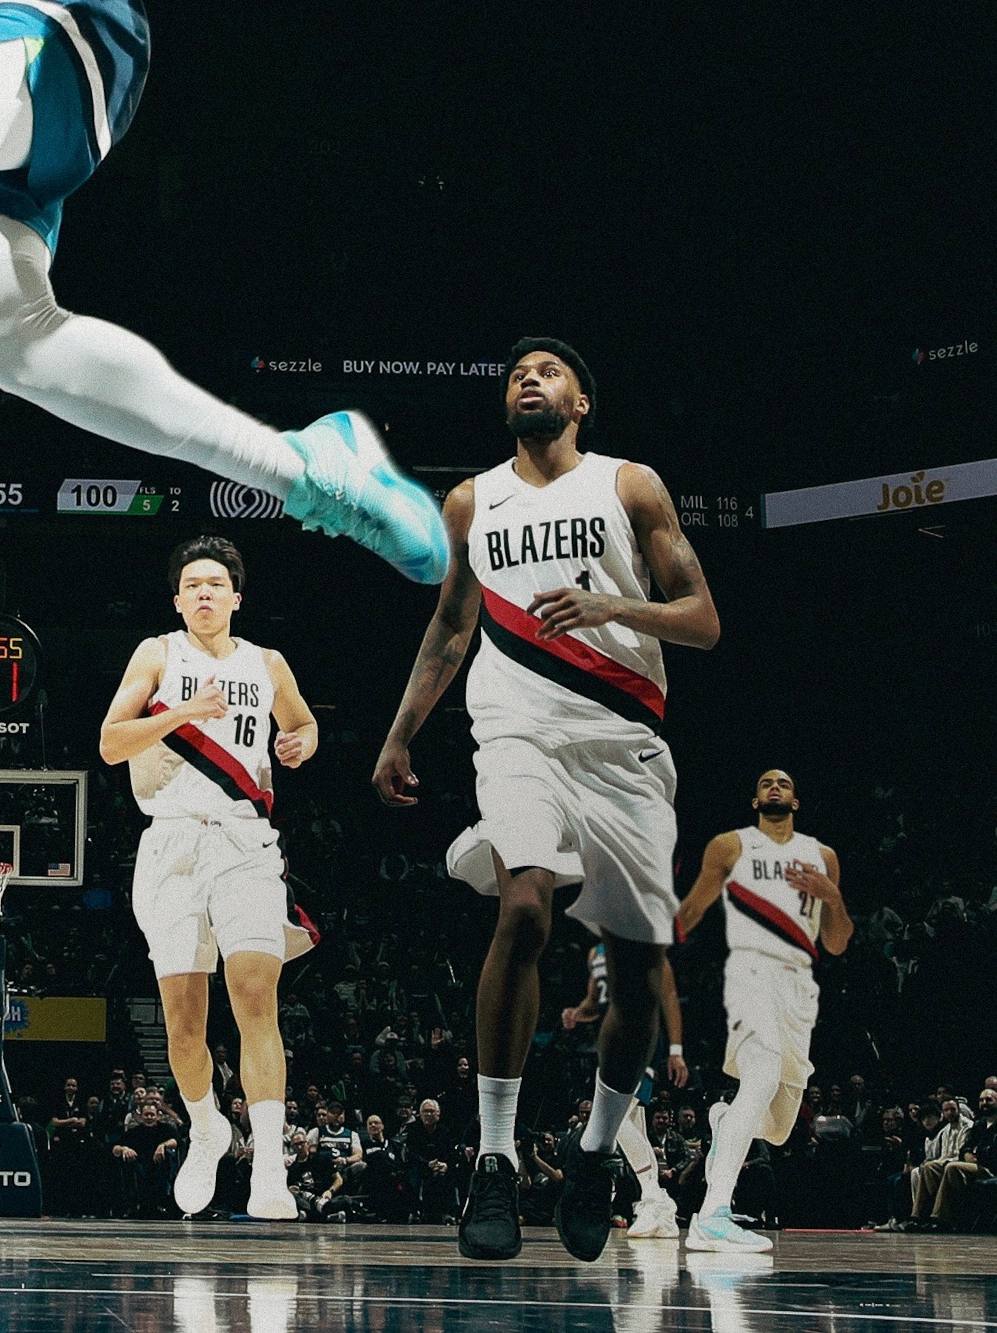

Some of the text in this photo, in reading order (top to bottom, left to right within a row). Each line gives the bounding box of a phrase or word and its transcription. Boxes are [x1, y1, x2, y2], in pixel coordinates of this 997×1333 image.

[928, 340, 979, 361] sezzle
[268, 358, 322, 373] sezzle
[343, 360, 375, 373] BUY
[379, 361, 422, 375] NOW.
[427, 362, 456, 375] PAY
[71, 484, 118, 508] 100
[876, 471, 946, 511] Joie
[142, 499, 151, 511] 5
[171, 500, 180, 512] 2
[680, 495, 738, 510] MIL 116
[680, 512, 739, 527] ORL 108
[744, 505, 755, 519] 4
[485, 516, 606, 571] BLAZERS
[233, 713, 256, 747] 16
